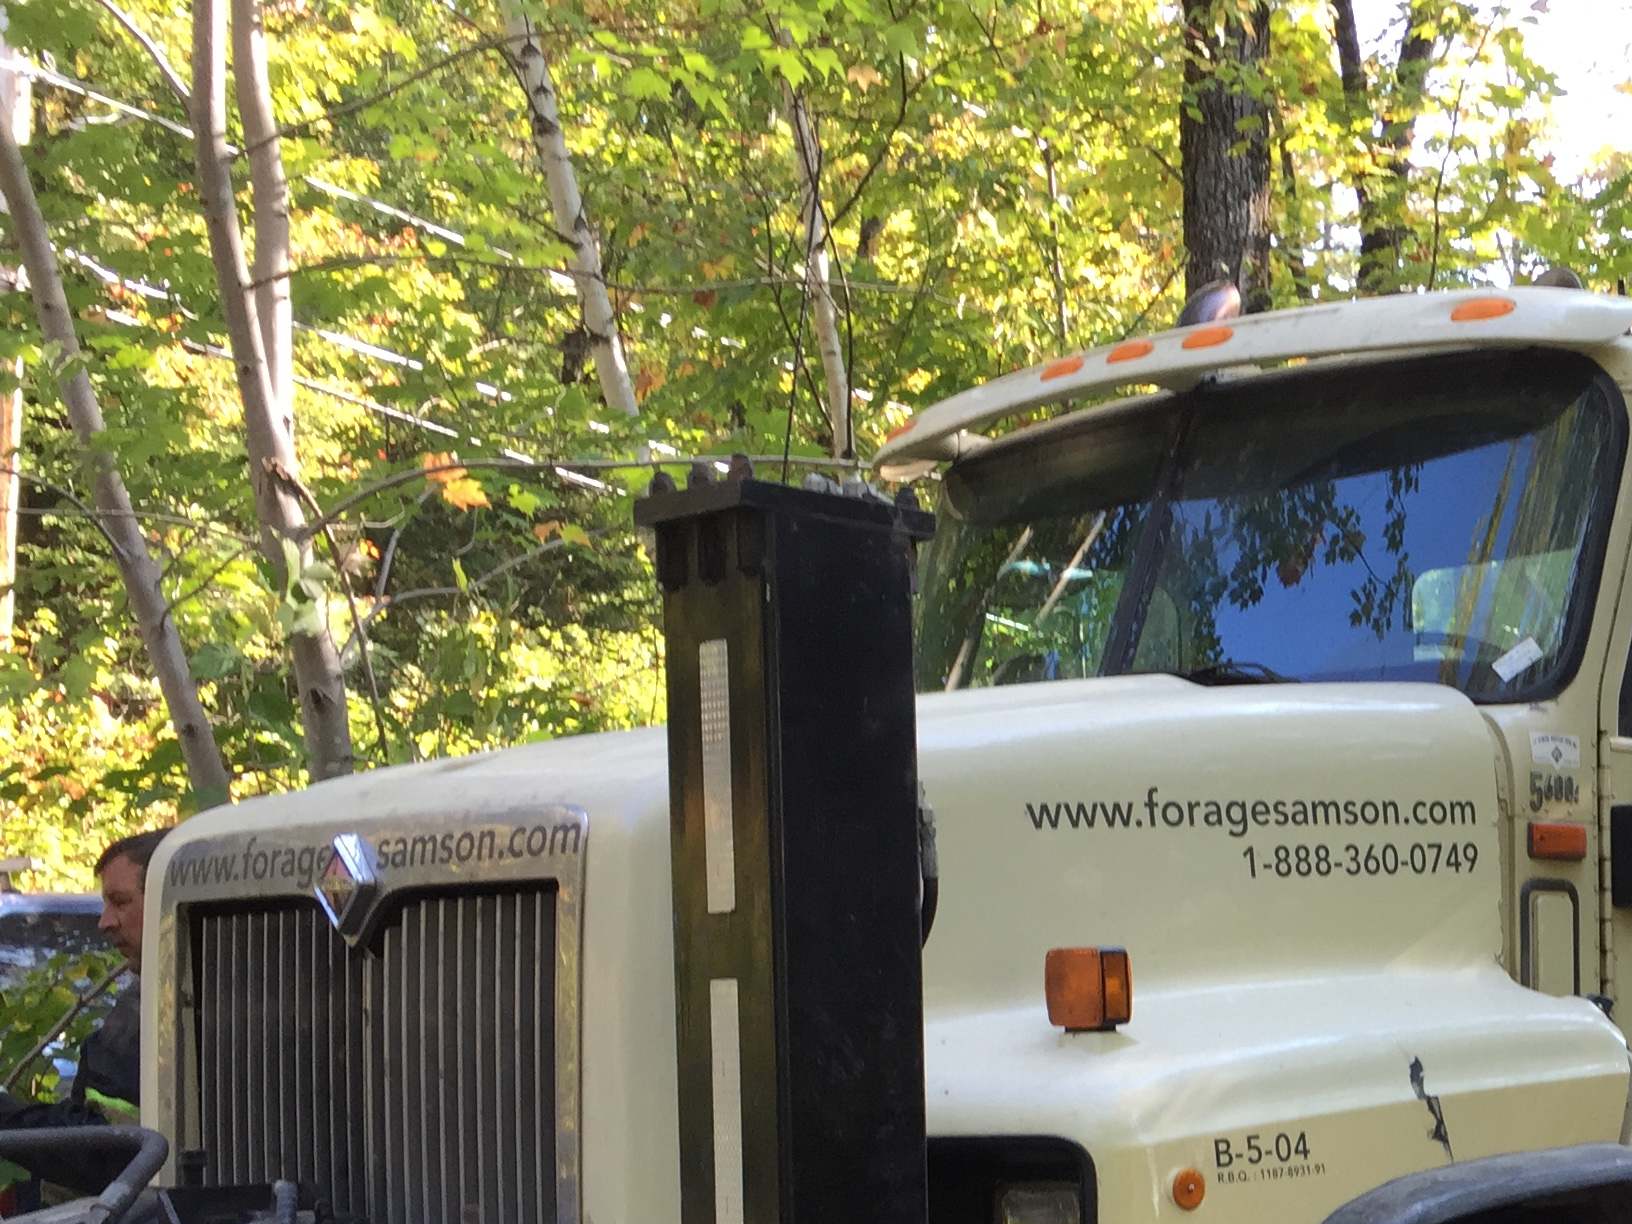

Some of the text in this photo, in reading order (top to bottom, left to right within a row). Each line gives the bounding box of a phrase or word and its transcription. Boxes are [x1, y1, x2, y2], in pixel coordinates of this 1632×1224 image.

[1025, 786, 1477, 837] www.foragesamson.com
[1243, 842, 1479, 879] 1-888-360-0749
[1214, 1131, 1311, 1168] B-5-04
